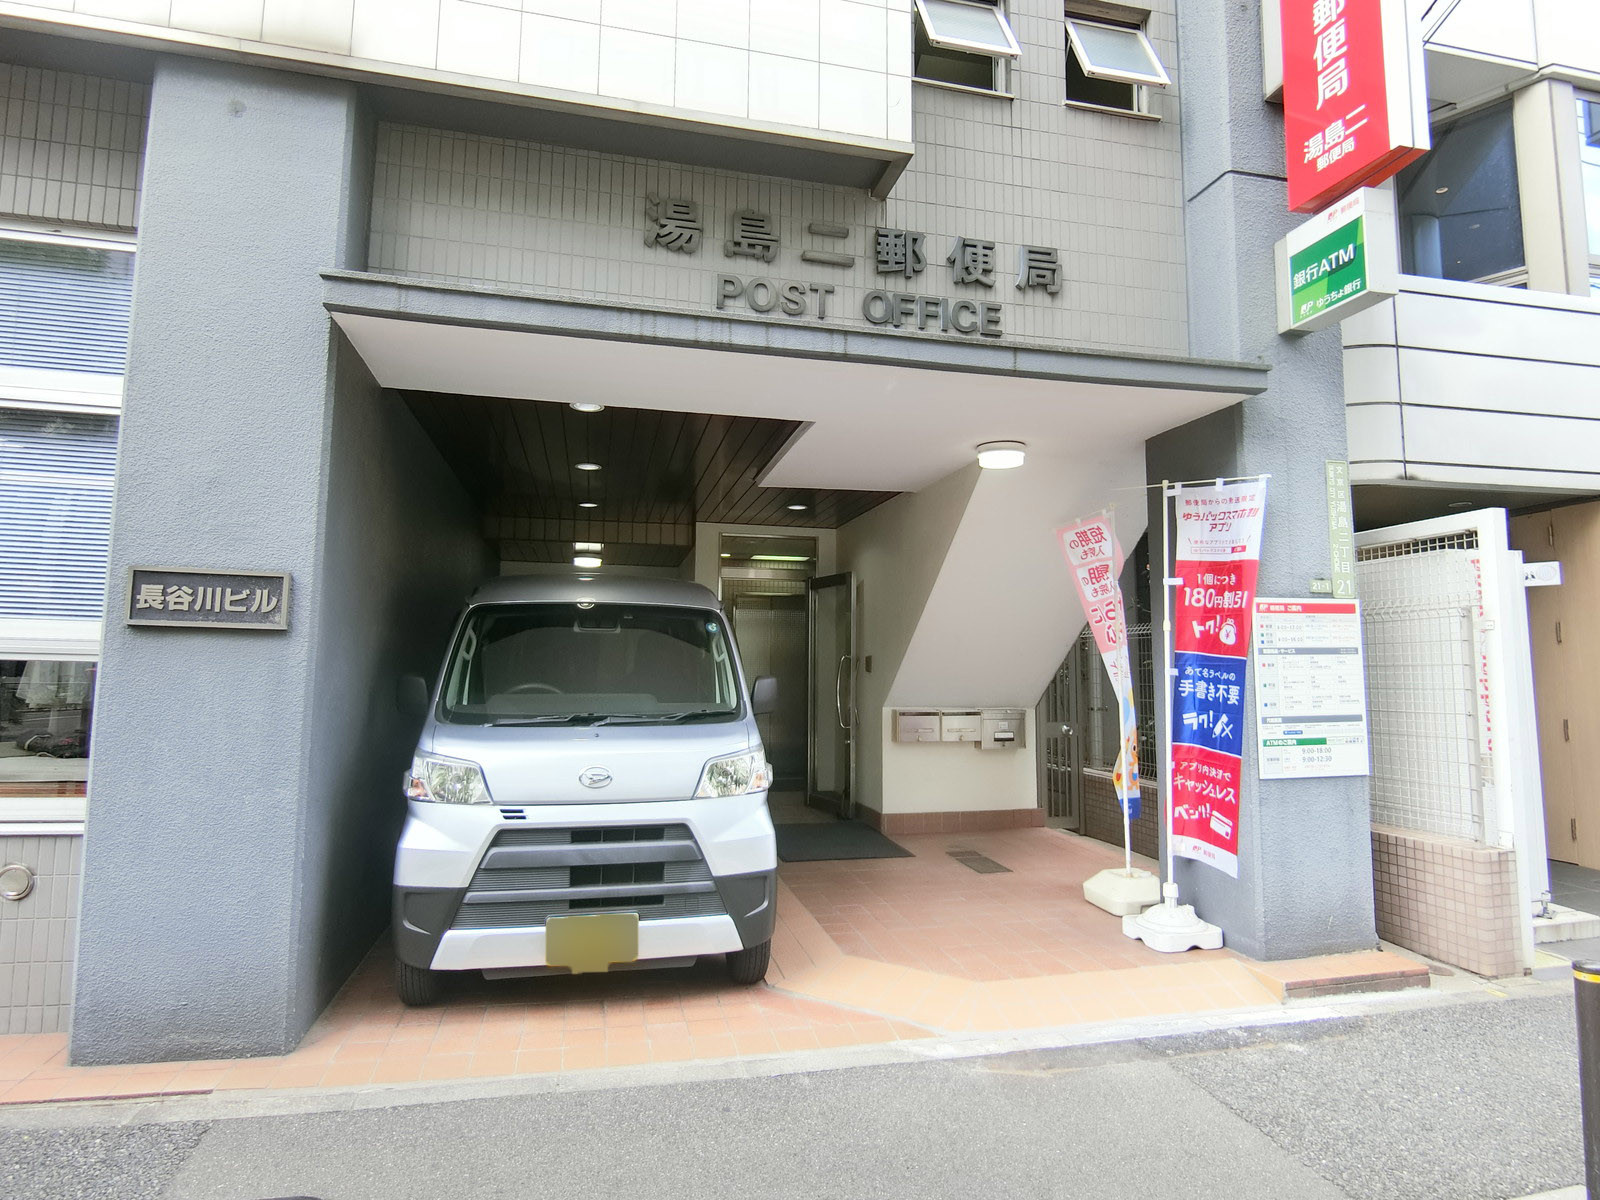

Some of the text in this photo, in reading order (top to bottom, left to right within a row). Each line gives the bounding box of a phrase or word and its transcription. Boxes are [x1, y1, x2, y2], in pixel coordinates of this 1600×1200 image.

[1304, 104, 1368, 164] 湯島二
[1293, 243, 1356, 290] 銀行ATM
[716, 273, 1002, 337] POST OFFICE
[1316, 278, 1361, 308] ゆうちょ銀行
[1197, 573, 1237, 586] 1個につき
[1337, 579, 1350, 594] 21
[136, 583, 279, 613] 長谷川ビル
[1183, 587, 1248, 608] 180円割引
[1184, 665, 1236, 681] あて名ラベルの
[1178, 679, 1241, 706] 手書き不要
[1180, 761, 1233, 782] アプリ内決済で
[1173, 773, 1236, 804] キャッシュレス
